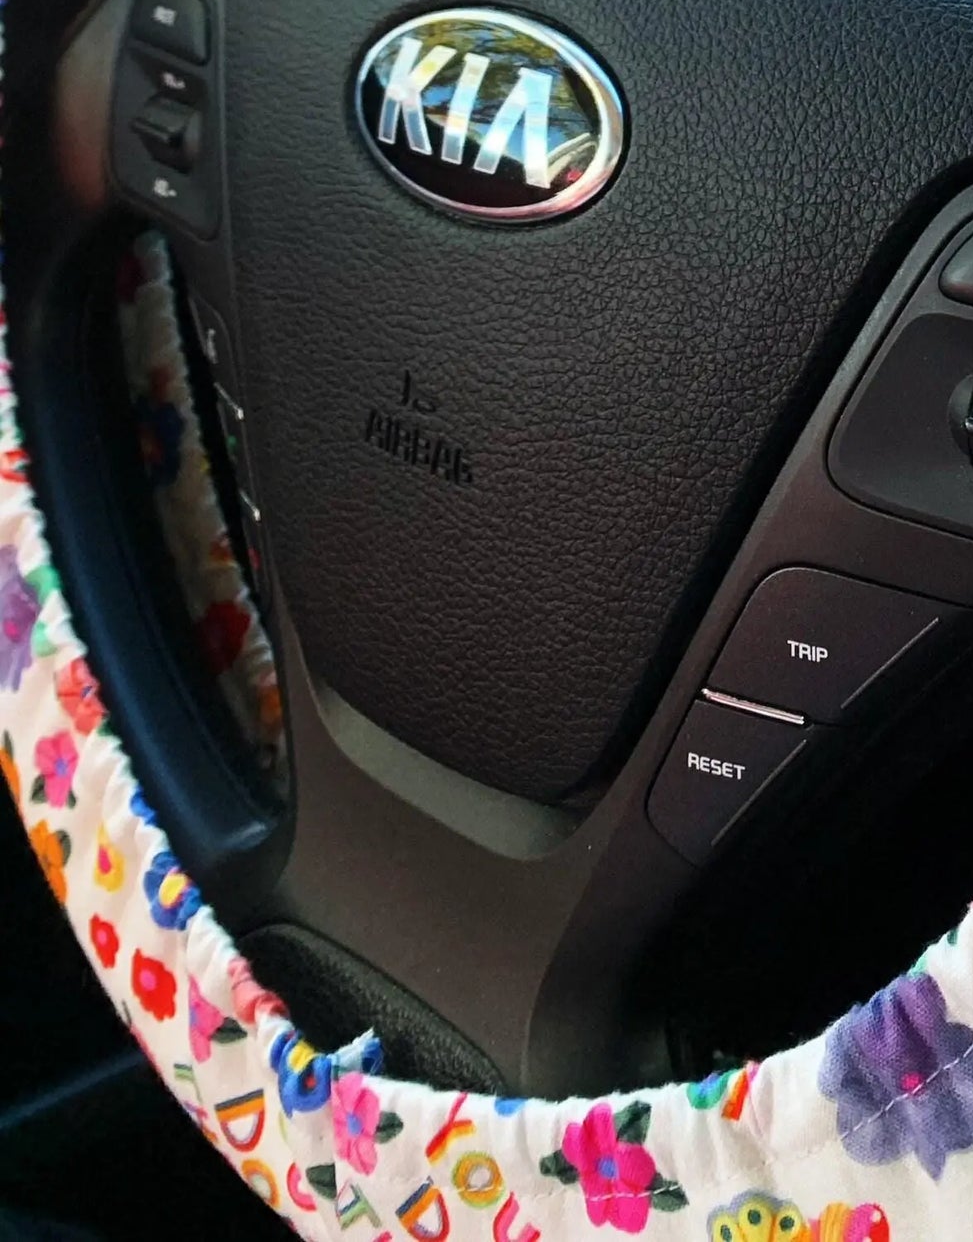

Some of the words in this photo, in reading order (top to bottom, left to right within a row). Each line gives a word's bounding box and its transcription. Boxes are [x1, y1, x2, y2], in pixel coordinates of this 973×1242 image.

[377, 36, 550, 190] KIA
[786, 638, 829, 664] TRIP
[686, 752, 747, 781] RESET
